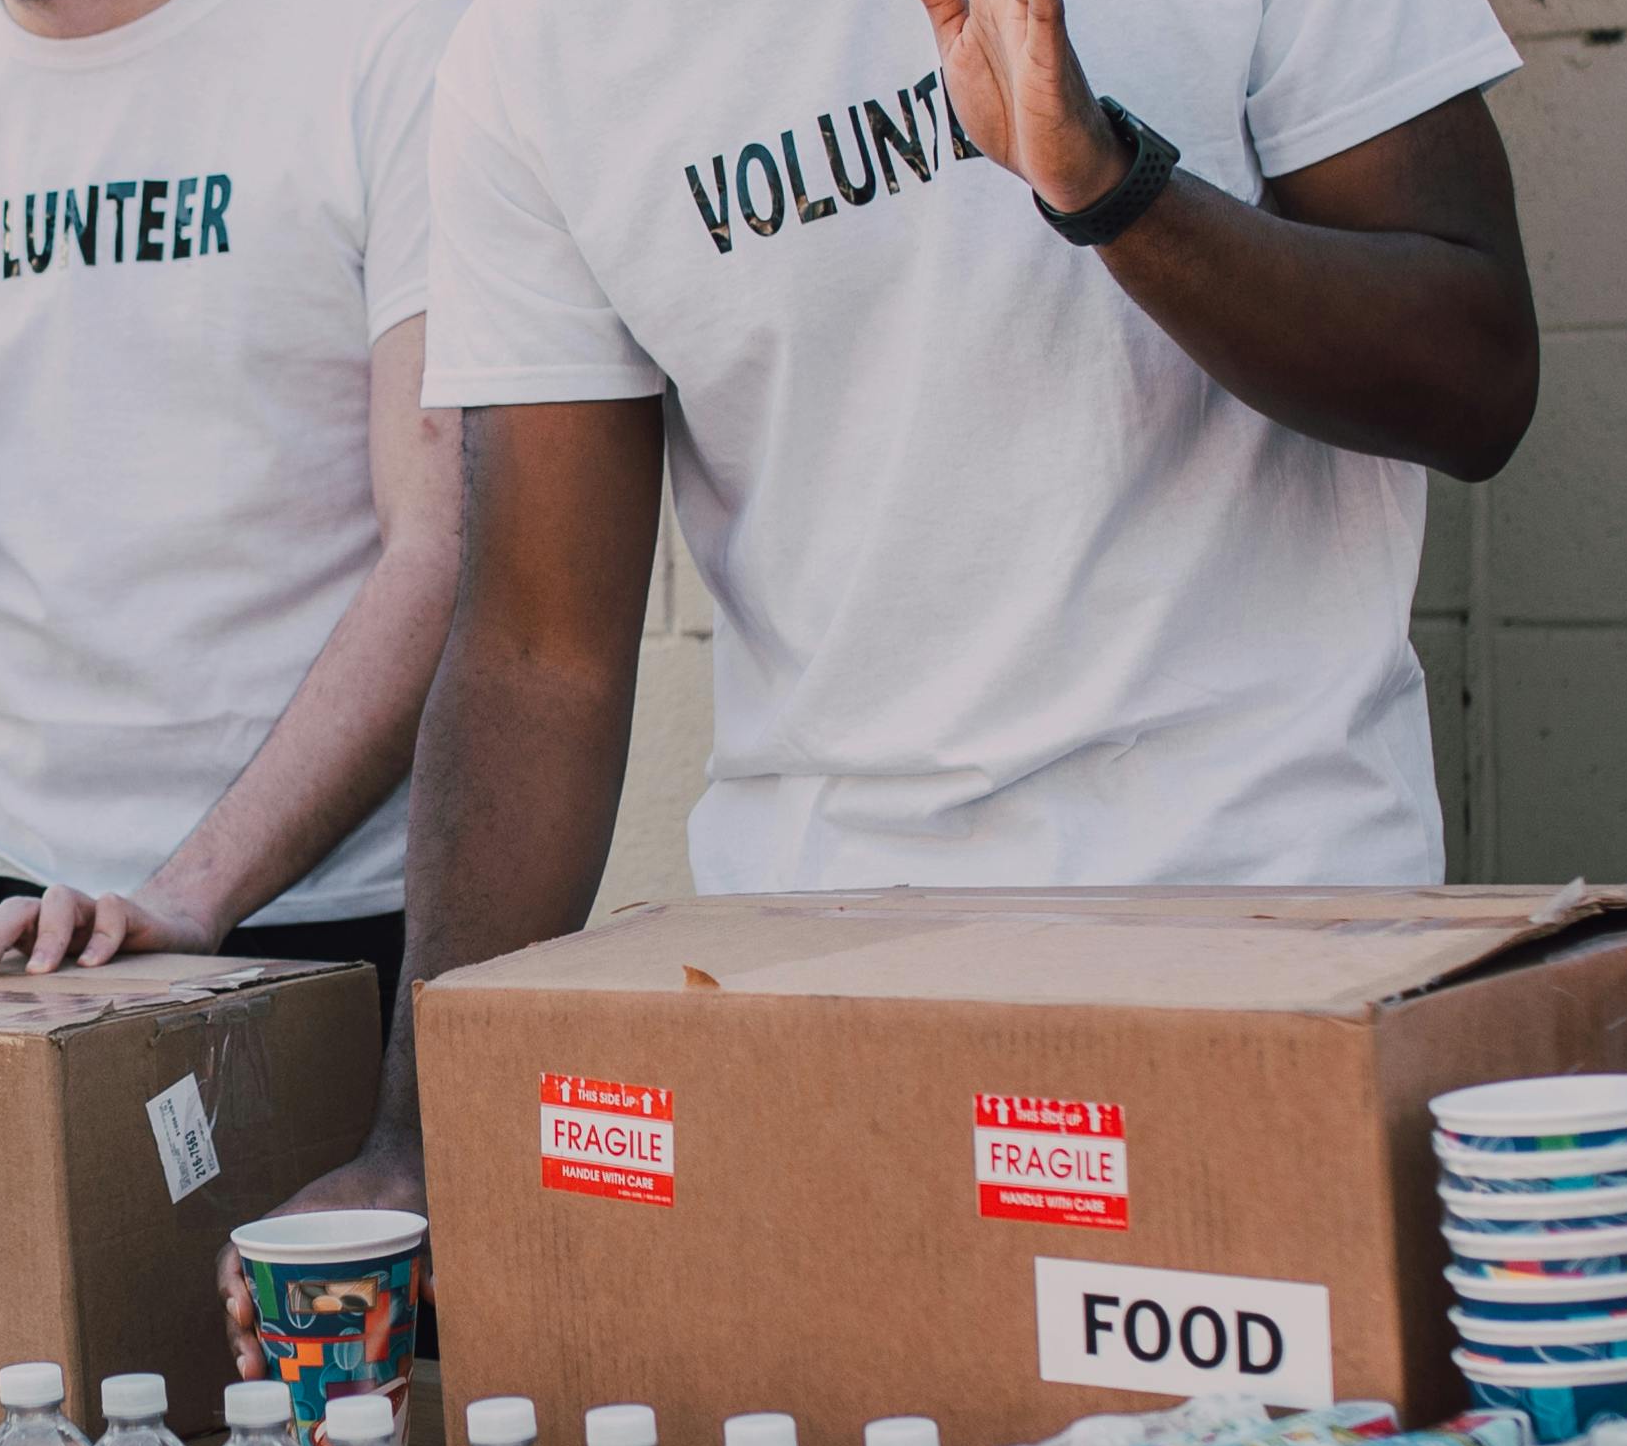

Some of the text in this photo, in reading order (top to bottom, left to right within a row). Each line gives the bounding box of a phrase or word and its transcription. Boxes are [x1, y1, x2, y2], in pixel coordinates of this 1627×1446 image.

[578, 1088, 636, 1108] THIS SIDE UP
[554, 1119, 662, 1162] FRAGILE
[562, 1165, 654, 1190] HANDLE WITH CARE
[991, 1142, 1113, 1182] FRAGILE
[1073, 1197, 1106, 1214] CARE
[1083, 1292, 1284, 1375] FOOD
